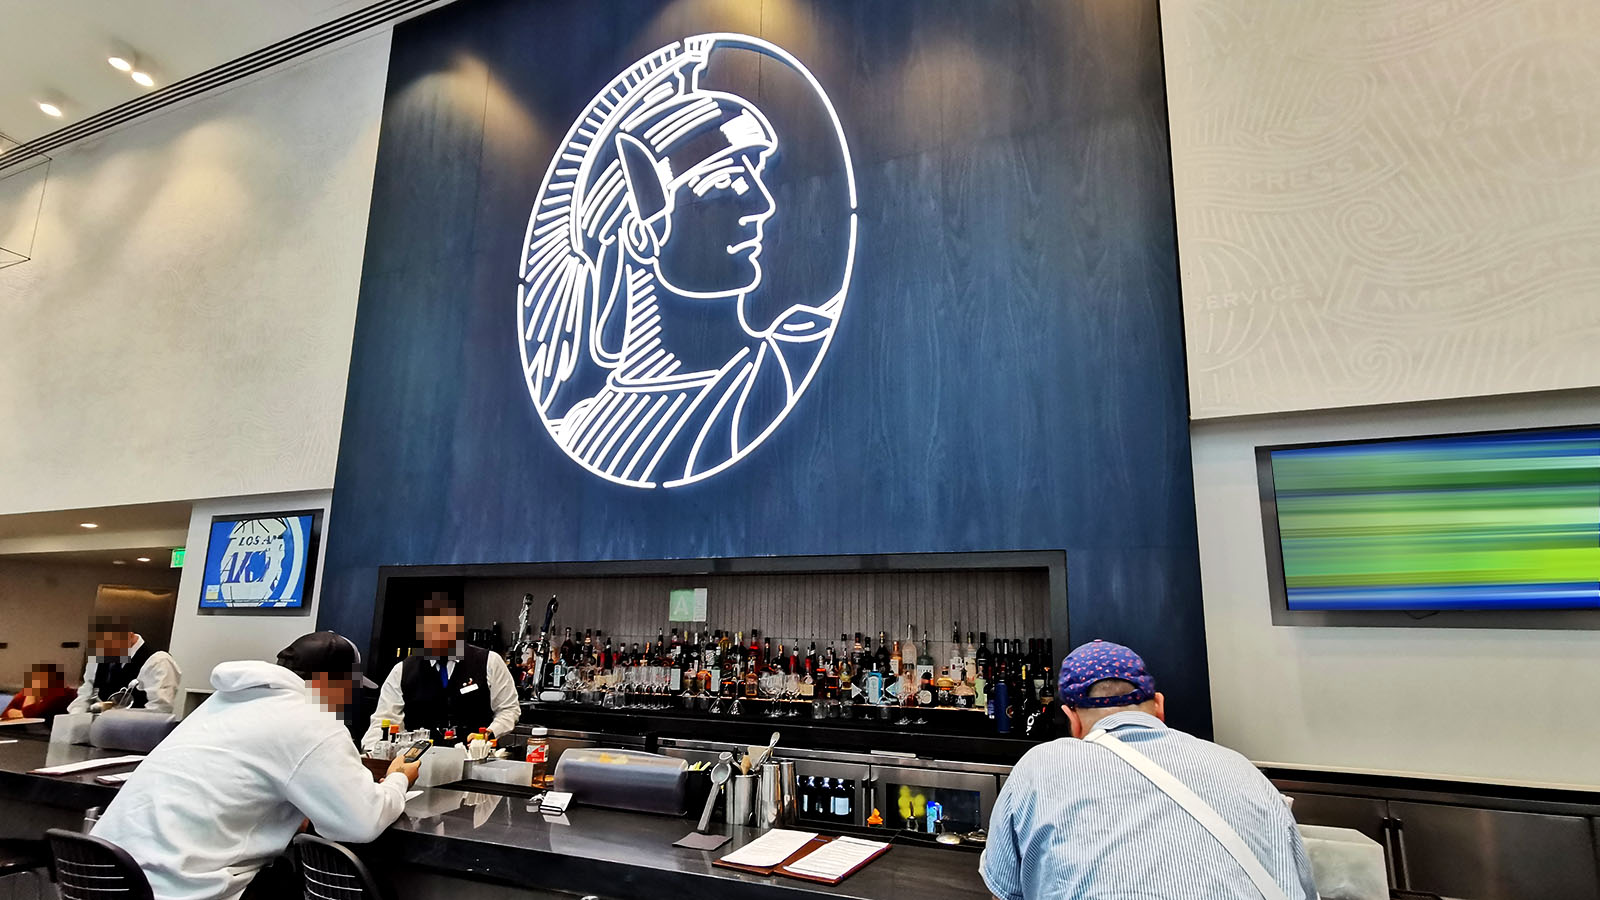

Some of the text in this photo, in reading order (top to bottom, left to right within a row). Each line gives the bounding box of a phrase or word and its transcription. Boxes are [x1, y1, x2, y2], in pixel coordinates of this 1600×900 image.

[1201, 155, 1356, 191] EXPRESS
[1370, 243, 1592, 311] AMERICAN
[1191, 284, 1307, 312] SERVICE
[239, 535, 261, 546] LOS
[673, 594, 689, 616] A
